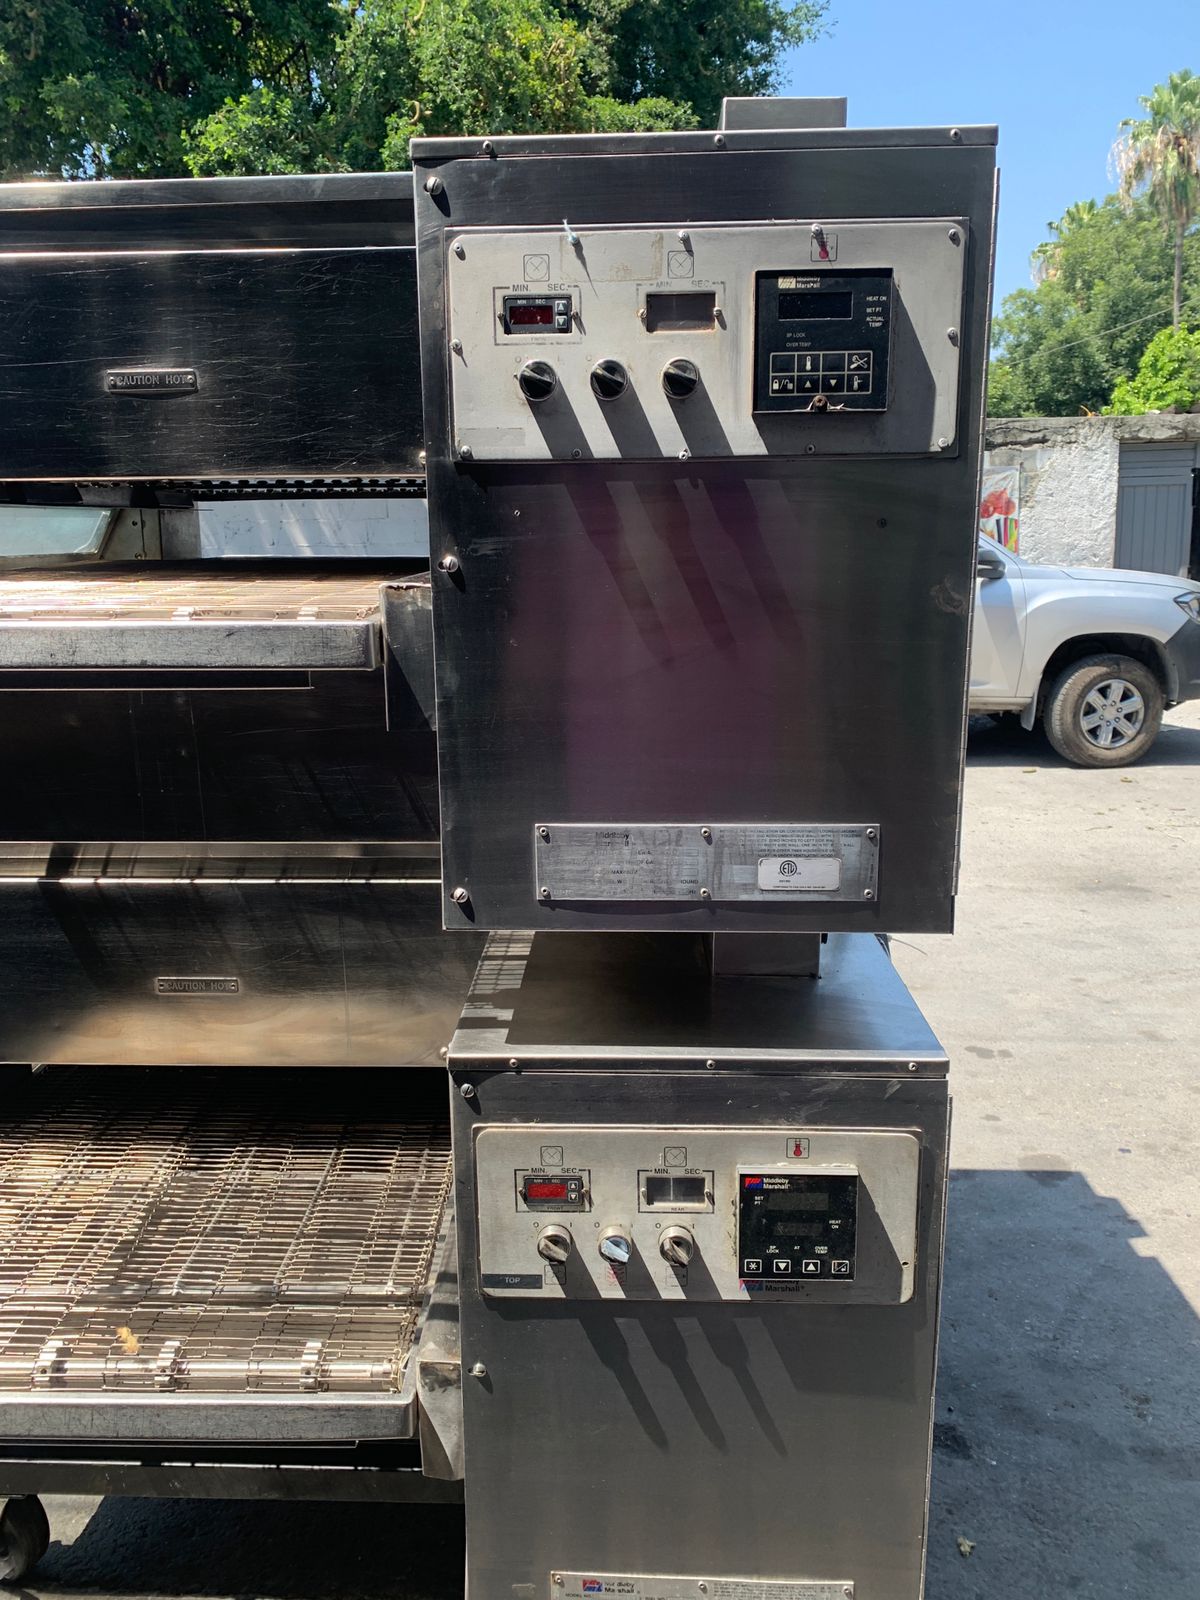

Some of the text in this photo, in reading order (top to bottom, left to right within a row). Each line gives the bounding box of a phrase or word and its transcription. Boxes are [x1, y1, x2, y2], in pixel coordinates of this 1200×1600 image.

[547, 283, 569, 292] SEC.
[116, 374, 185, 386] CAUTION HOT
[166, 982, 230, 990] CAUTION HOT
[505, 1276, 520, 1284] TOP
